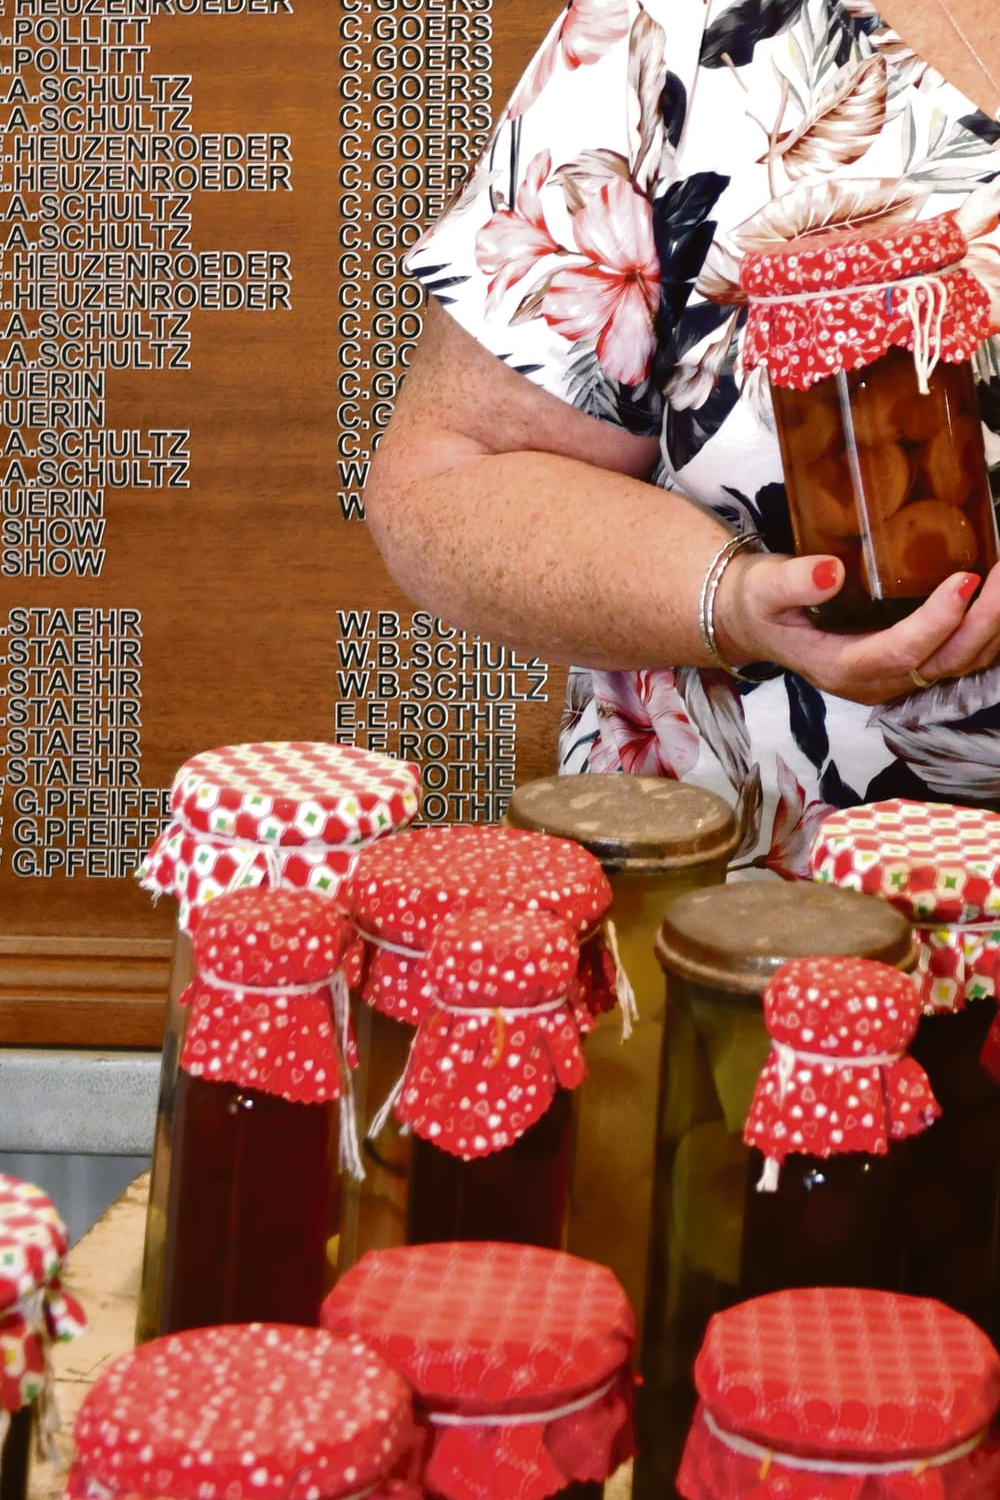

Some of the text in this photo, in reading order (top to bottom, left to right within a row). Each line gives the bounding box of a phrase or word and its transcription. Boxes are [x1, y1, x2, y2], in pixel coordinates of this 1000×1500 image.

[0, 16, 151, 45] .POLLITT
[338, 14, 492, 44] C.GOERS
[0, 45, 151, 75] .POLLITT
[338, 44, 492, 74] C.GOERS
[338, 74, 492, 103] C.GOERS
[338, 103, 492, 133] C.GOERS
[0, 370, 105, 400] UERIN
[0, 400, 105, 429] UERIN
[0, 489, 105, 519] UERIN
[1, 518, 105, 548] SHOW
[1, 548, 105, 578] SHOW
[336, 670, 548, 702] W.B.SCHULZ
[335, 701, 516, 731] E.E.ROTHE
